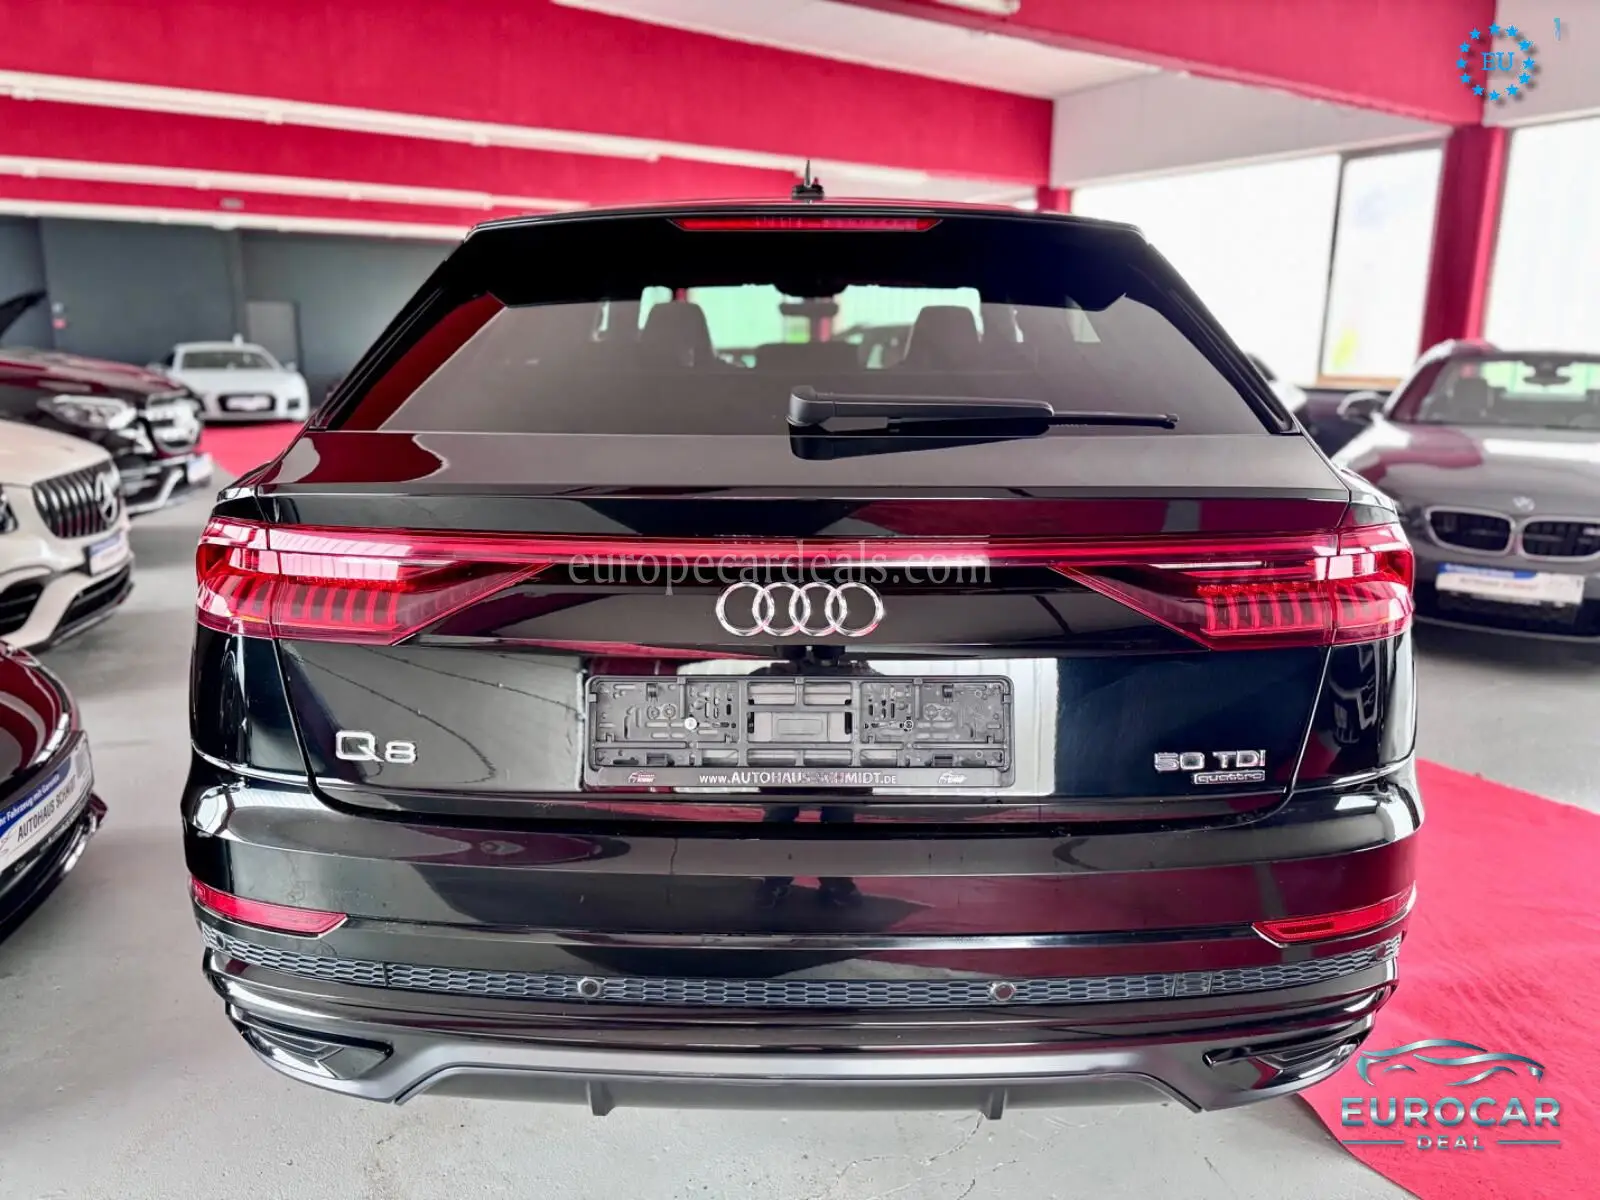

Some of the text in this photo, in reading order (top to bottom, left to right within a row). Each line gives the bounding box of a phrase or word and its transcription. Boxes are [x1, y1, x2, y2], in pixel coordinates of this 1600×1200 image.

[335, 730, 418, 764] Q8
[1154, 749, 1266, 772] 50 TDI
[1197, 772, 1263, 784] quattro
[17, 799, 56, 843] AUTOHAUS
